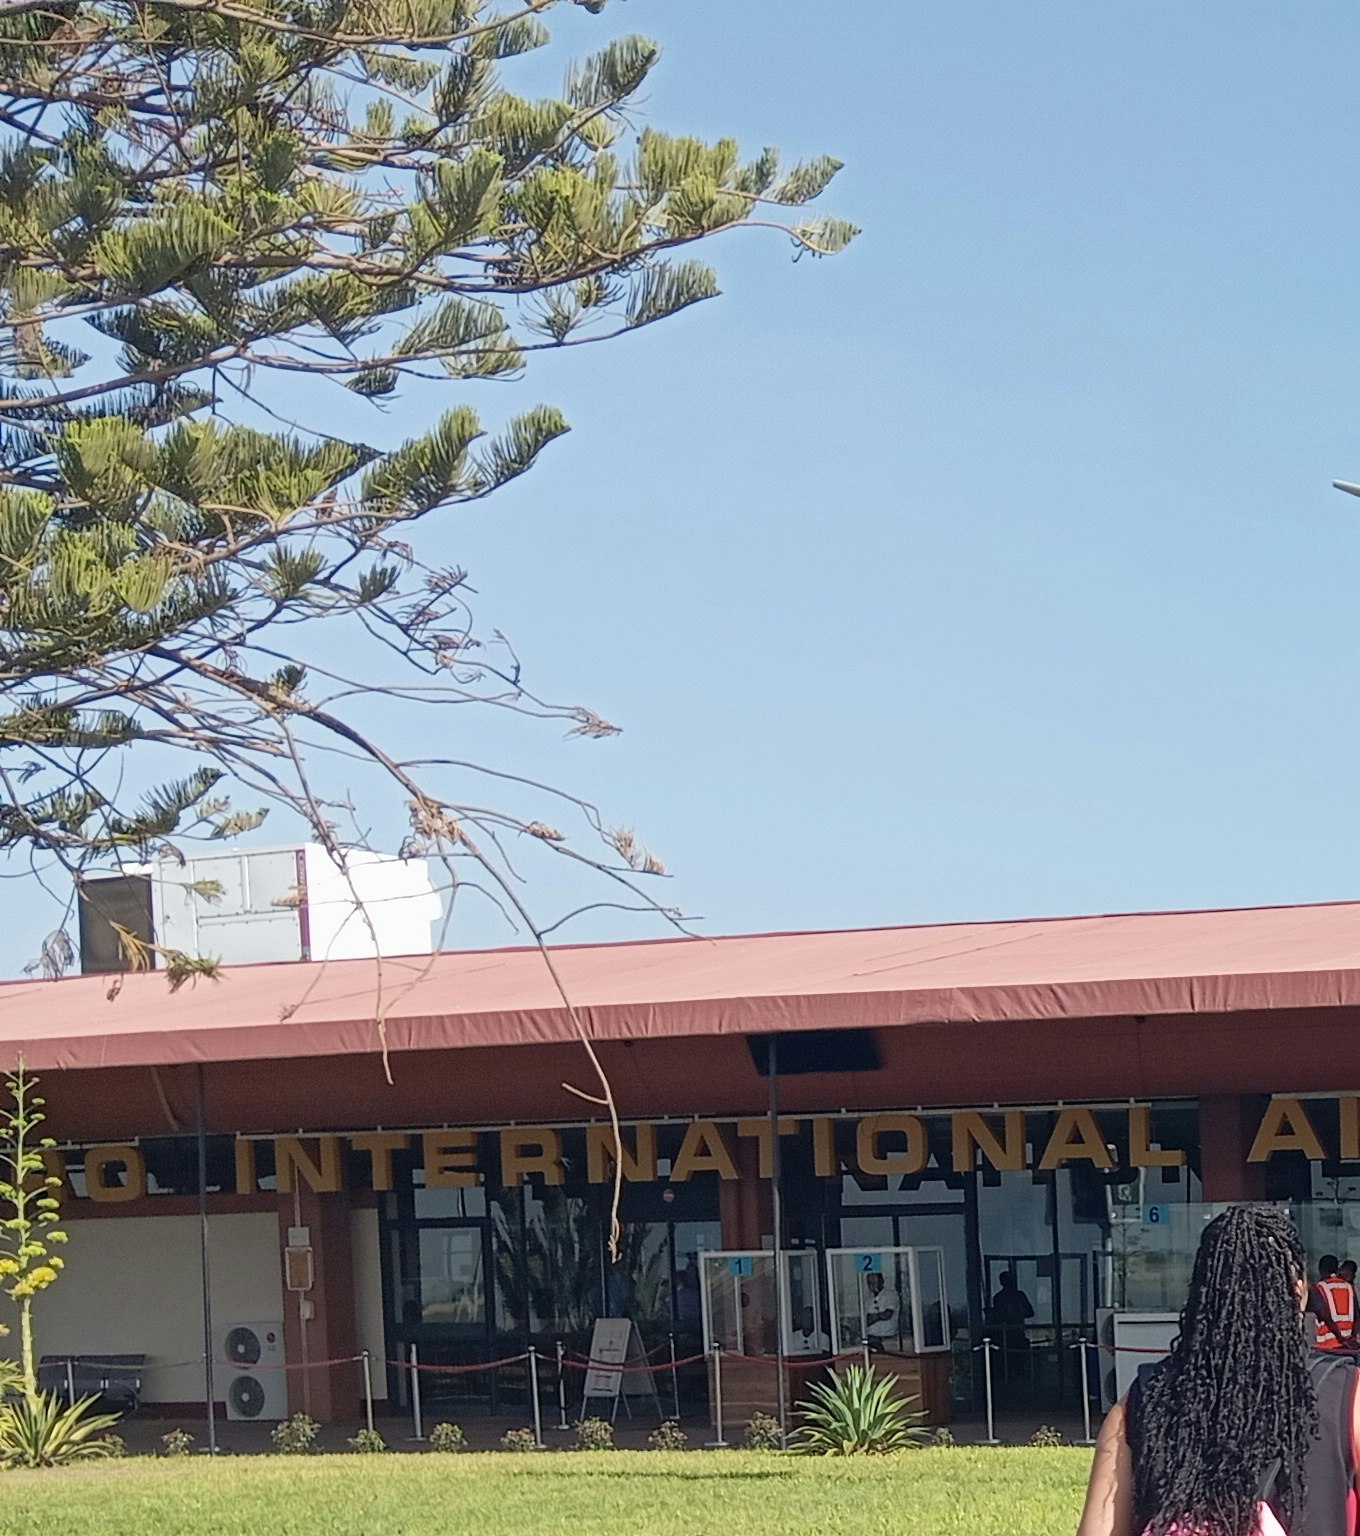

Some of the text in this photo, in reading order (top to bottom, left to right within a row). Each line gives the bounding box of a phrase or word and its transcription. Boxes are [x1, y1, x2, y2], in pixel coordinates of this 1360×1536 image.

[235, 1106, 1187, 1195] INTERNATIONAL
[1149, 1206, 1160, 1223] 6
[735, 1259, 743, 1273] 1
[863, 1255, 873, 1271] 2
